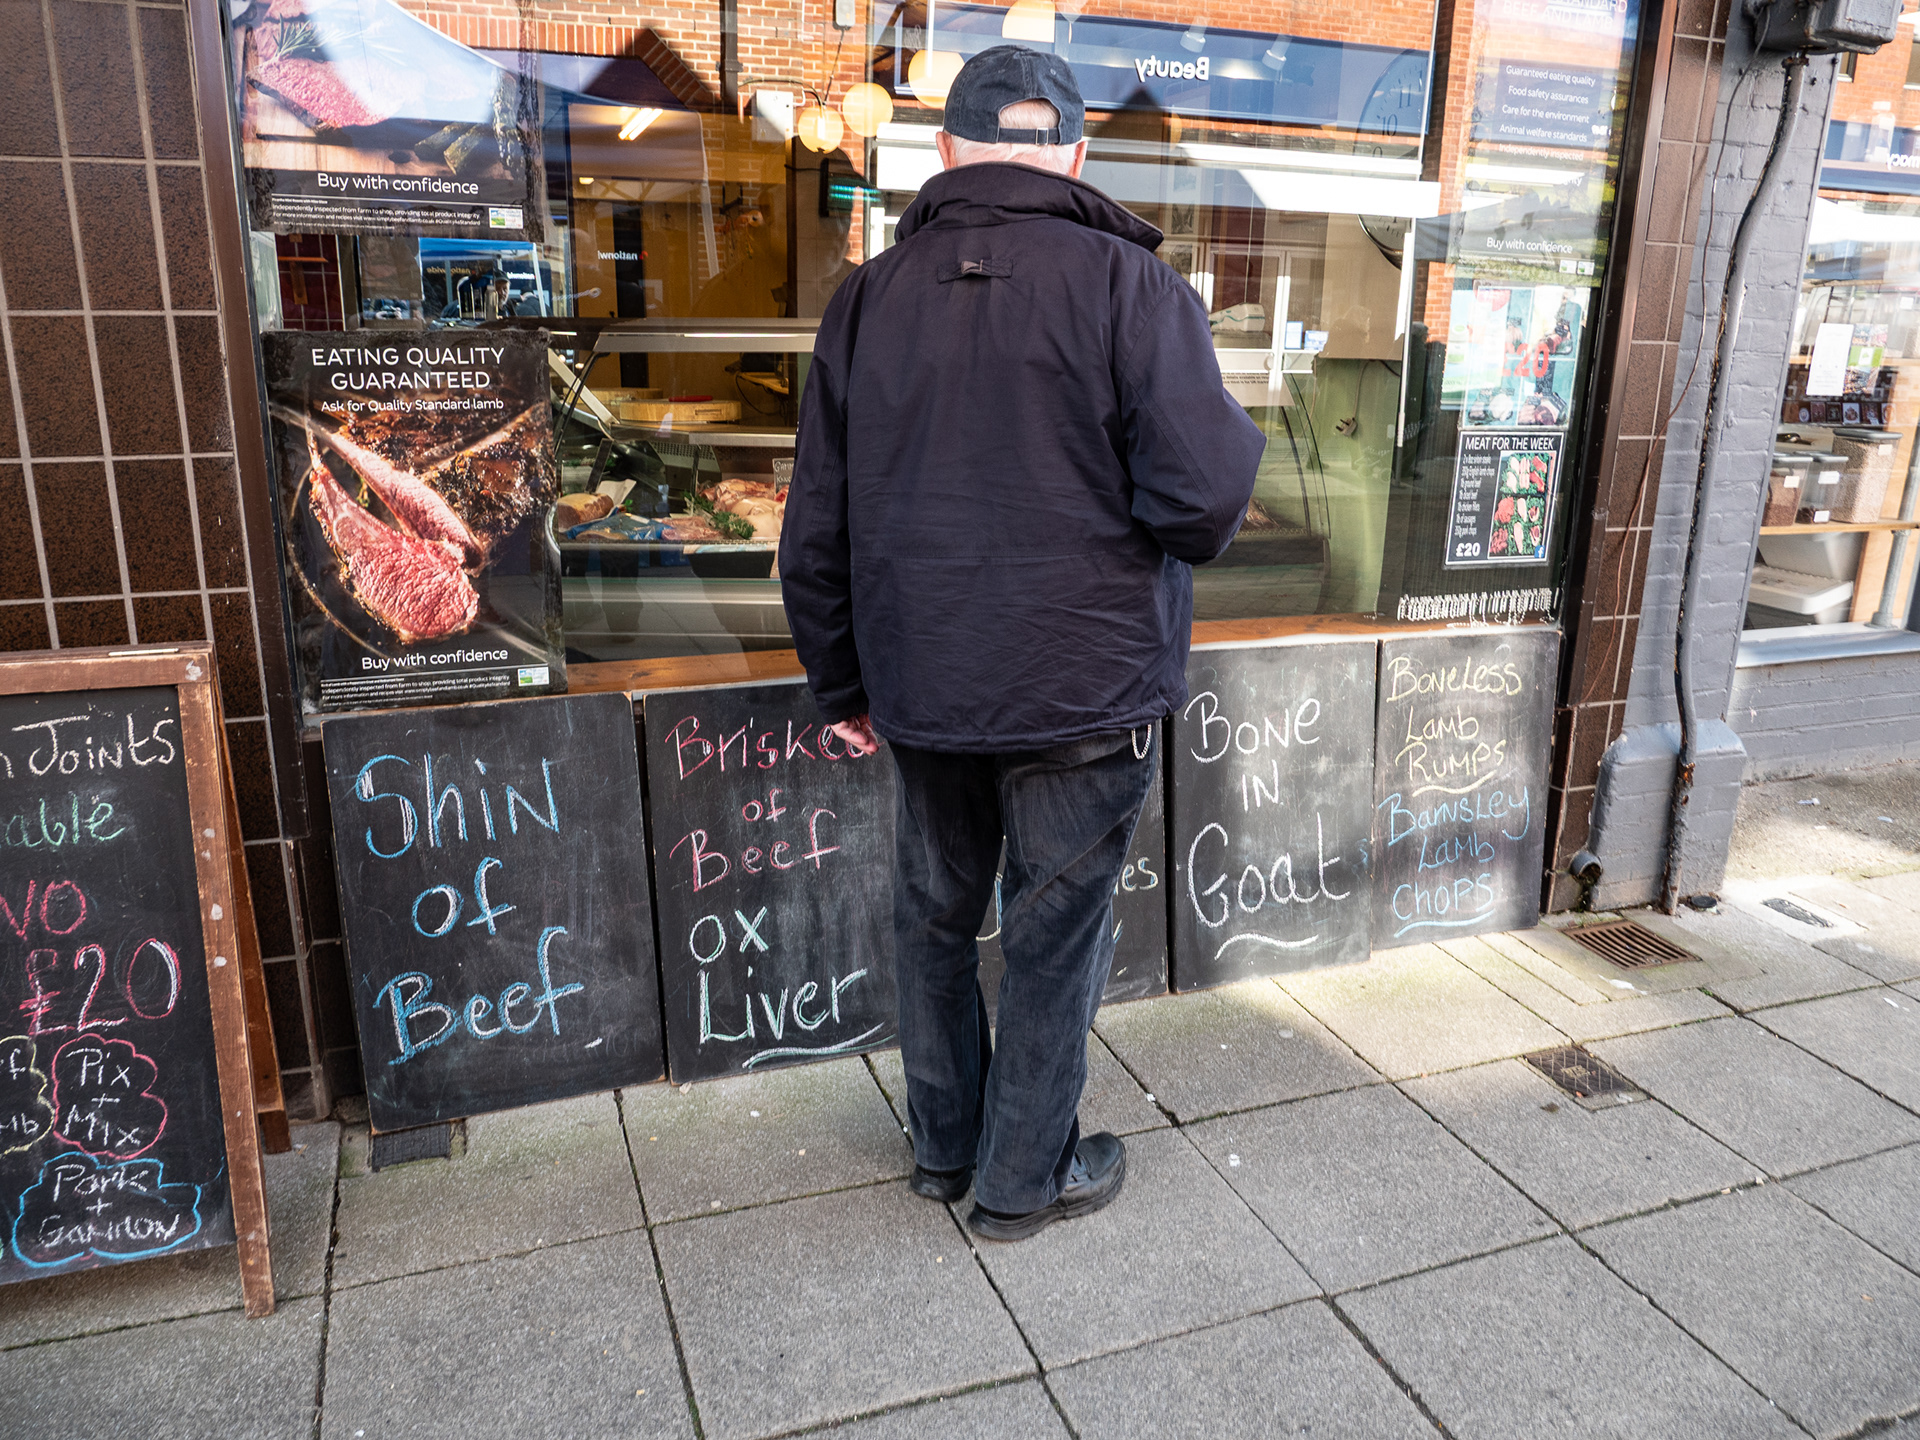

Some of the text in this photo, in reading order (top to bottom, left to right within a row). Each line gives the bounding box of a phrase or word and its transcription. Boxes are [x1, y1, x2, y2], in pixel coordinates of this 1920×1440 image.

[1506, 65, 1596, 87] Guaranteed eating quality
[1508, 85, 1589, 104] Food safety assurances
[1502, 104, 1589, 124] Care for the environment
[1499, 124, 1587, 142] Animal welfare standards
[1499, 144, 1584, 161] Independently inspected
[317, 173, 479, 195] Buy with confidence
[272, 204, 313, 213] Independently
[314, 206, 341, 214] inspected
[395, 209, 420, 218] providing
[434, 211, 456, 219] product
[457, 212, 480, 220] integrity
[1486, 237, 1573, 254] Buy with confidence
[312, 347, 504, 368] EATING QUALITY
[331, 371, 490, 390] GUARANTEED
[321, 398, 504, 413] Ask for Quality Standard lamb
[1465, 437, 1554, 450] MEAT FOR THE WEEK
[1455, 542, 1480, 557] £20
[362, 649, 508, 671] Buy with confidence
[322, 686, 359, 694] Independently
[359, 684, 384, 692] inspected
[432, 678, 455, 687] providing
[469, 676, 488, 684] product
[489, 674, 510, 682] integrity
[665, 715, 878, 781] Briske
[742, 789, 788, 823] of
[669, 807, 840, 892] Beef
[1187, 811, 1351, 928] Goat
[411, 857, 516, 937] of
[19, 938, 182, 1036] £20
[373, 926, 585, 1065] Beef
[699, 966, 868, 1045] Liver
[65, 1048, 131, 1088] Pix
